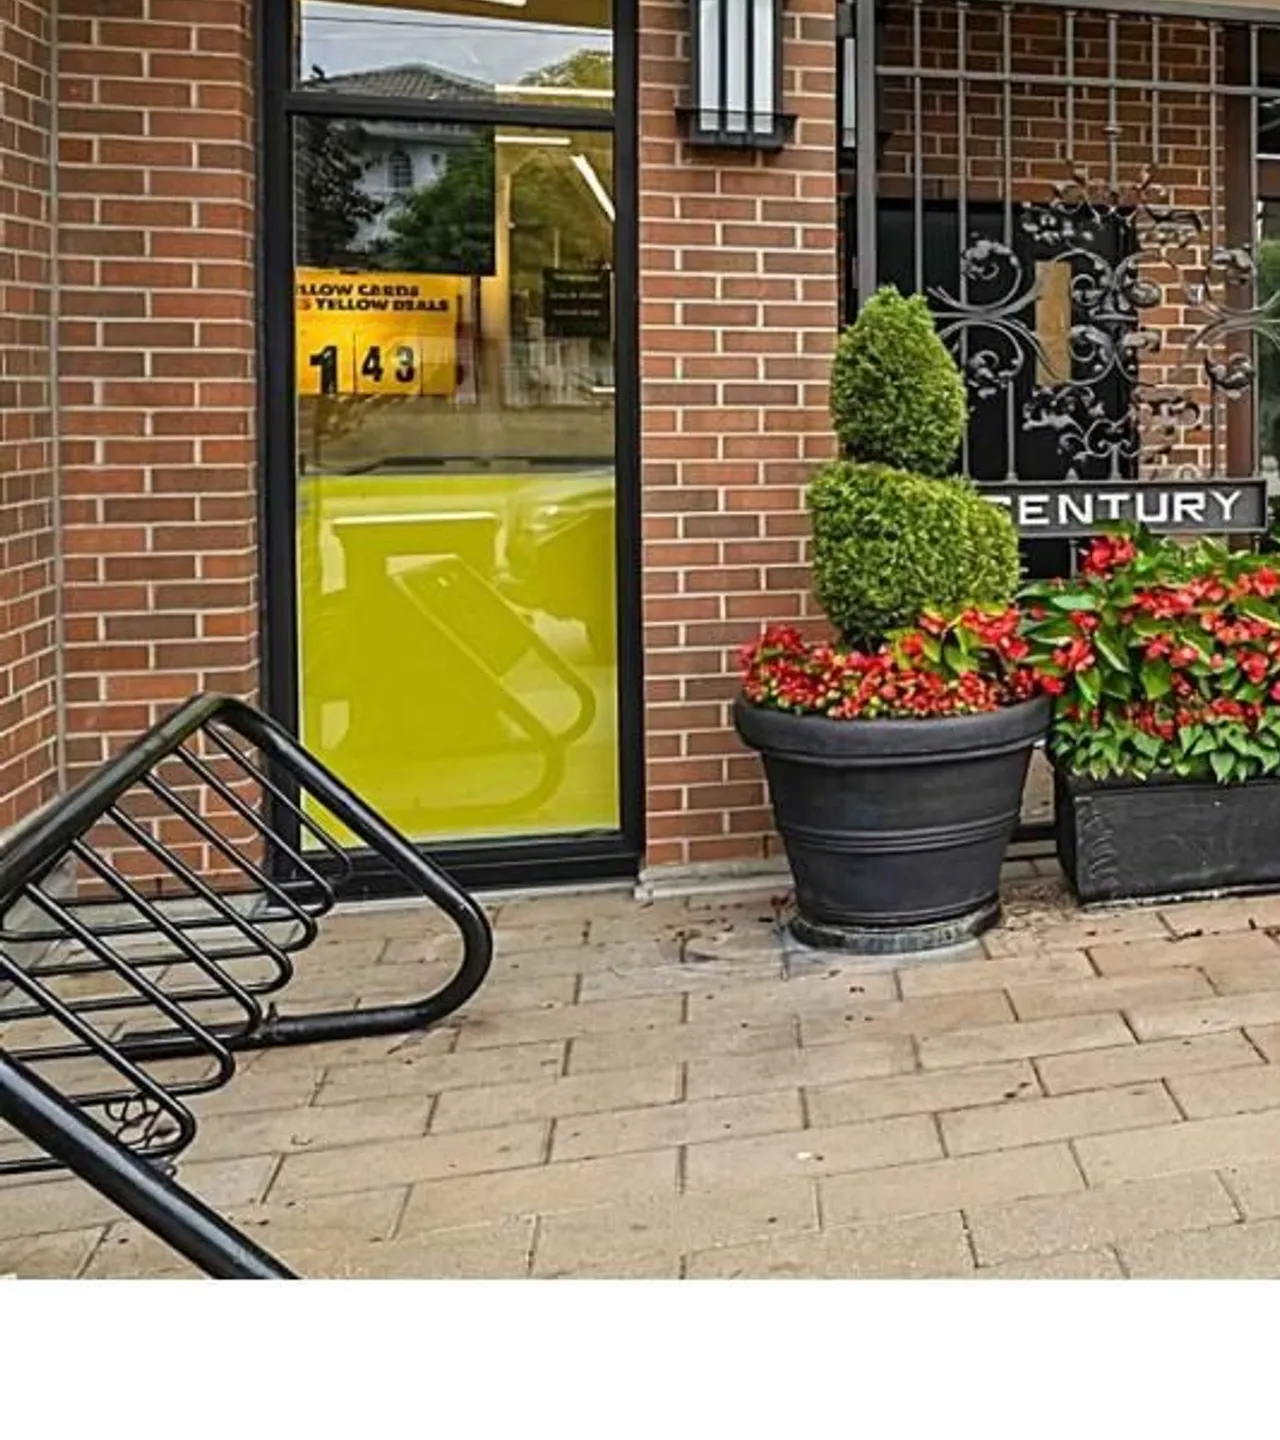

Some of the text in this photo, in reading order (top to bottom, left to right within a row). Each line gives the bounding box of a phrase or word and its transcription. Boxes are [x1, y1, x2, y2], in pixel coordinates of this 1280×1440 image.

[297, 283, 419, 296] LLOW CARDS
[315, 298, 388, 311] YELLOW
[393, 299, 449, 312] DEALS
